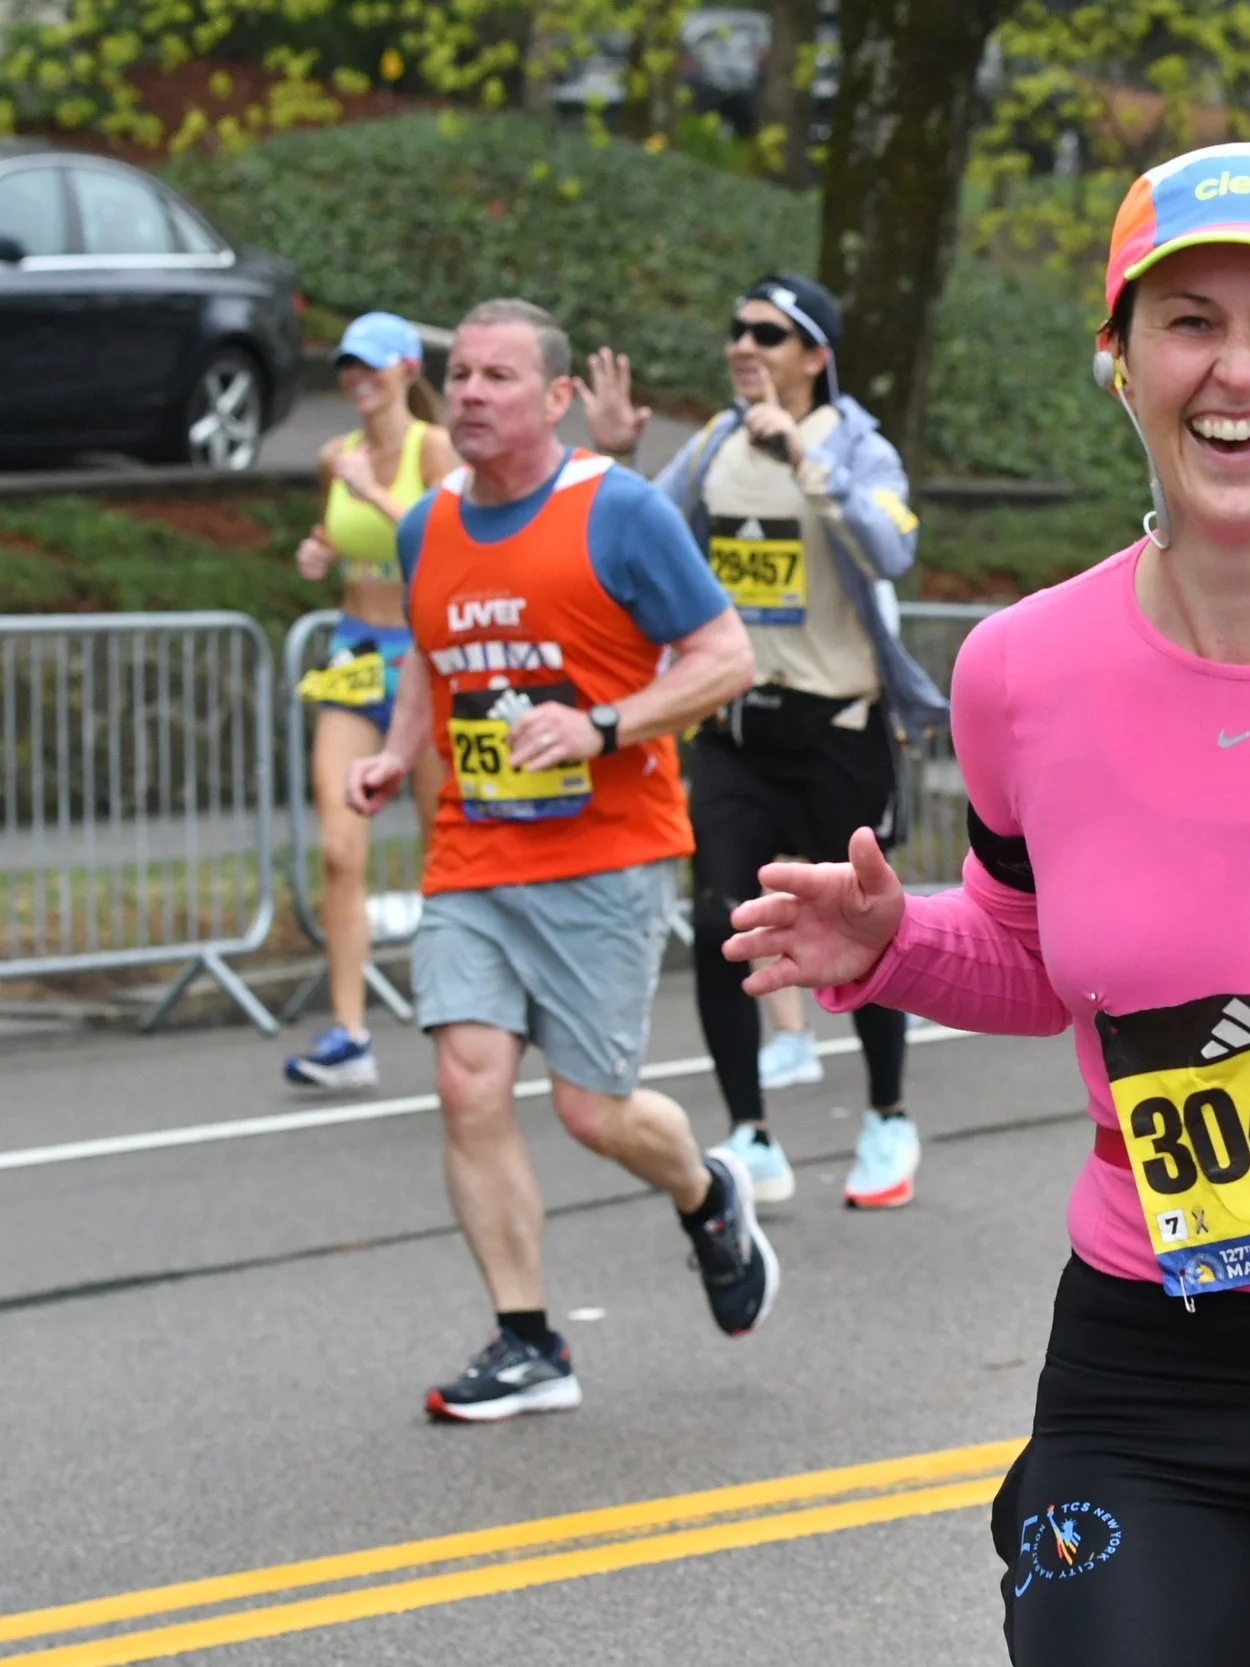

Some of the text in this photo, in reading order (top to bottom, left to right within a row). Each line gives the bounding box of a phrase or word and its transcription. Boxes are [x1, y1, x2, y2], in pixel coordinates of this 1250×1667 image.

[1165, 1217, 1179, 1236] 7
[1061, 1501, 1091, 1514] TCS
[1093, 1507, 1120, 1530] NEW
[1097, 1531, 1122, 1562] YORK
[1058, 1560, 1095, 1579] CITY
